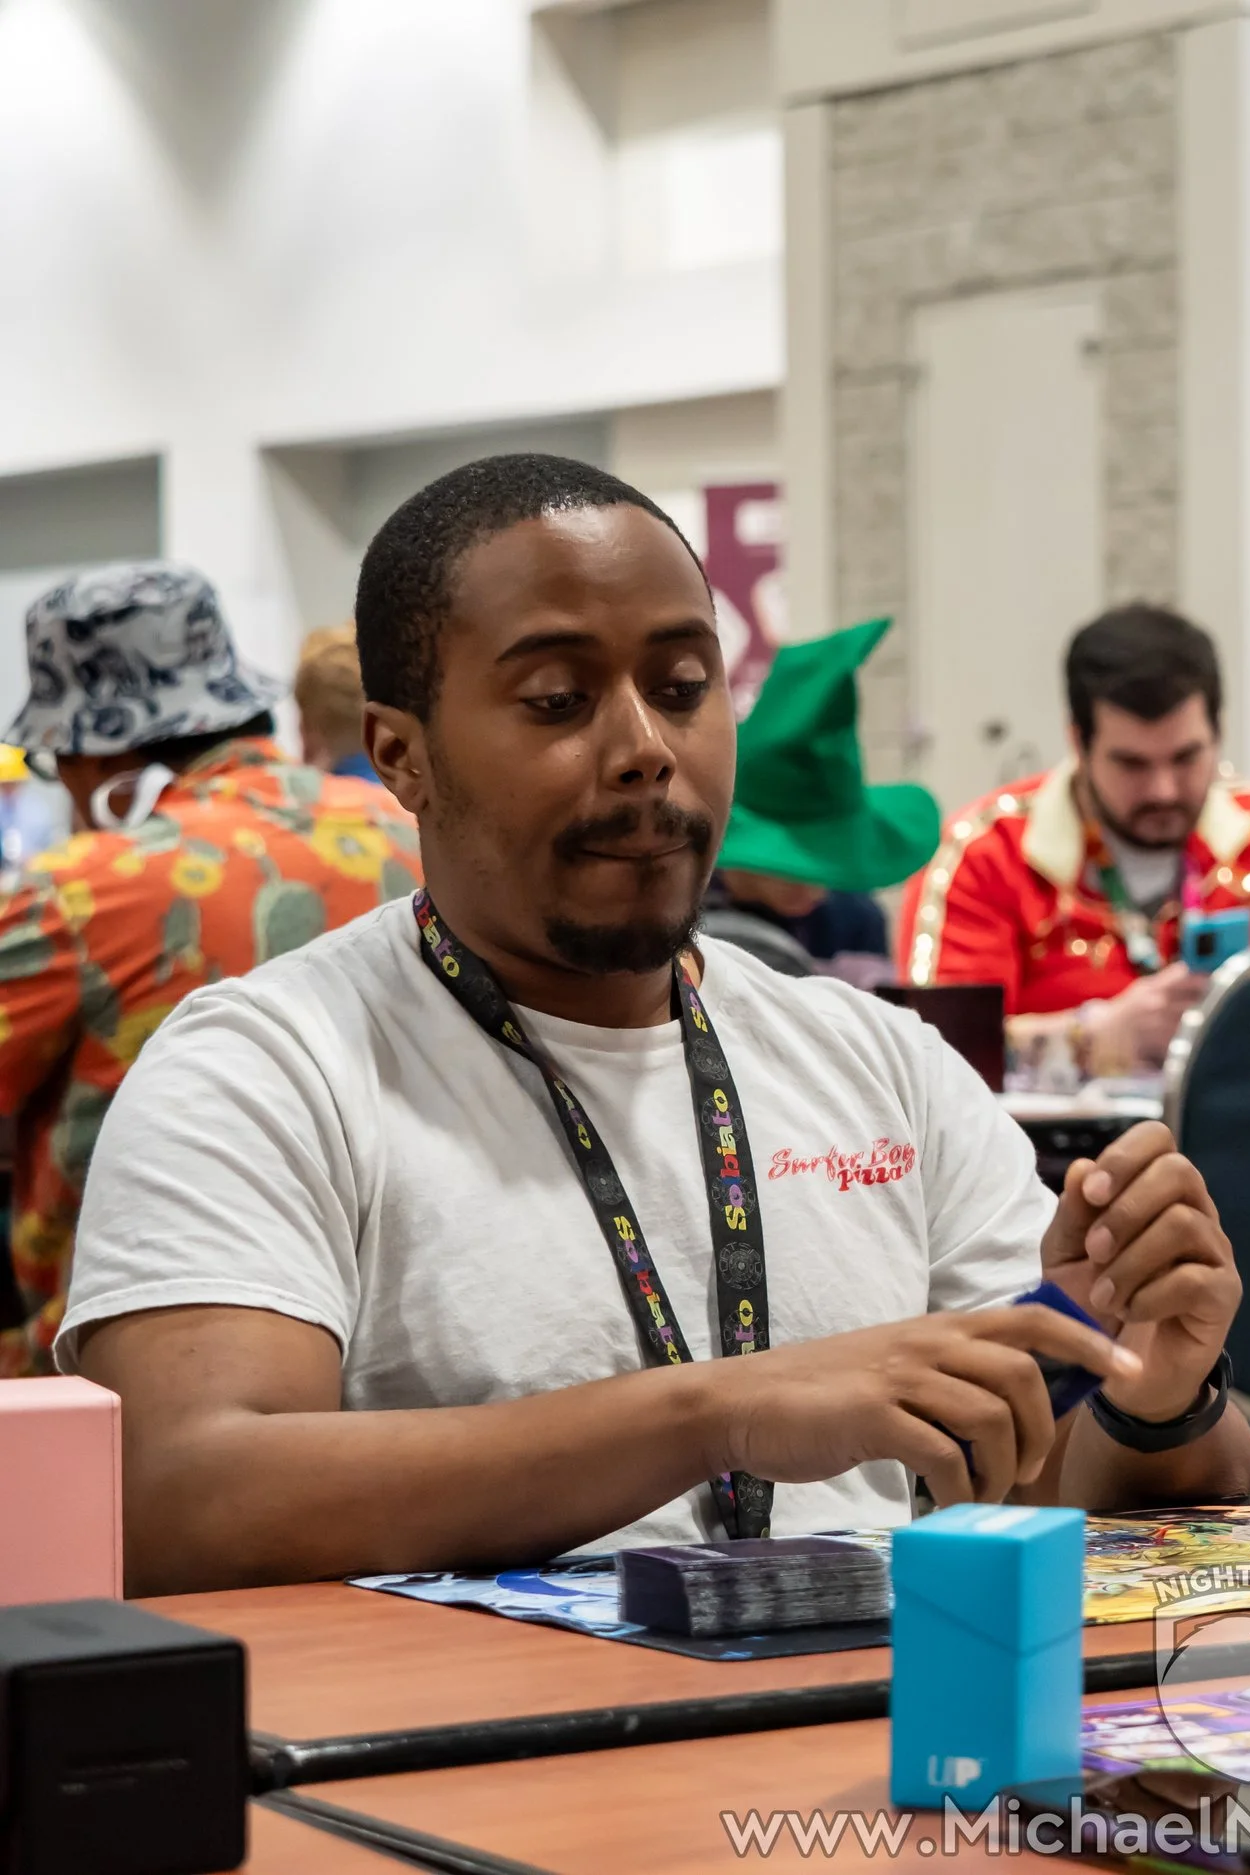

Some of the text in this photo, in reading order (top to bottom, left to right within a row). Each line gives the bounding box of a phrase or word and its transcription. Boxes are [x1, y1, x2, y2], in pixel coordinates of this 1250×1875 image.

[702, 1087, 748, 1231] Solbiato
[767, 1137, 916, 1181] Surfer Boy
[613, 1215, 682, 1364] Solbiato
[928, 1755, 982, 1788] UP
